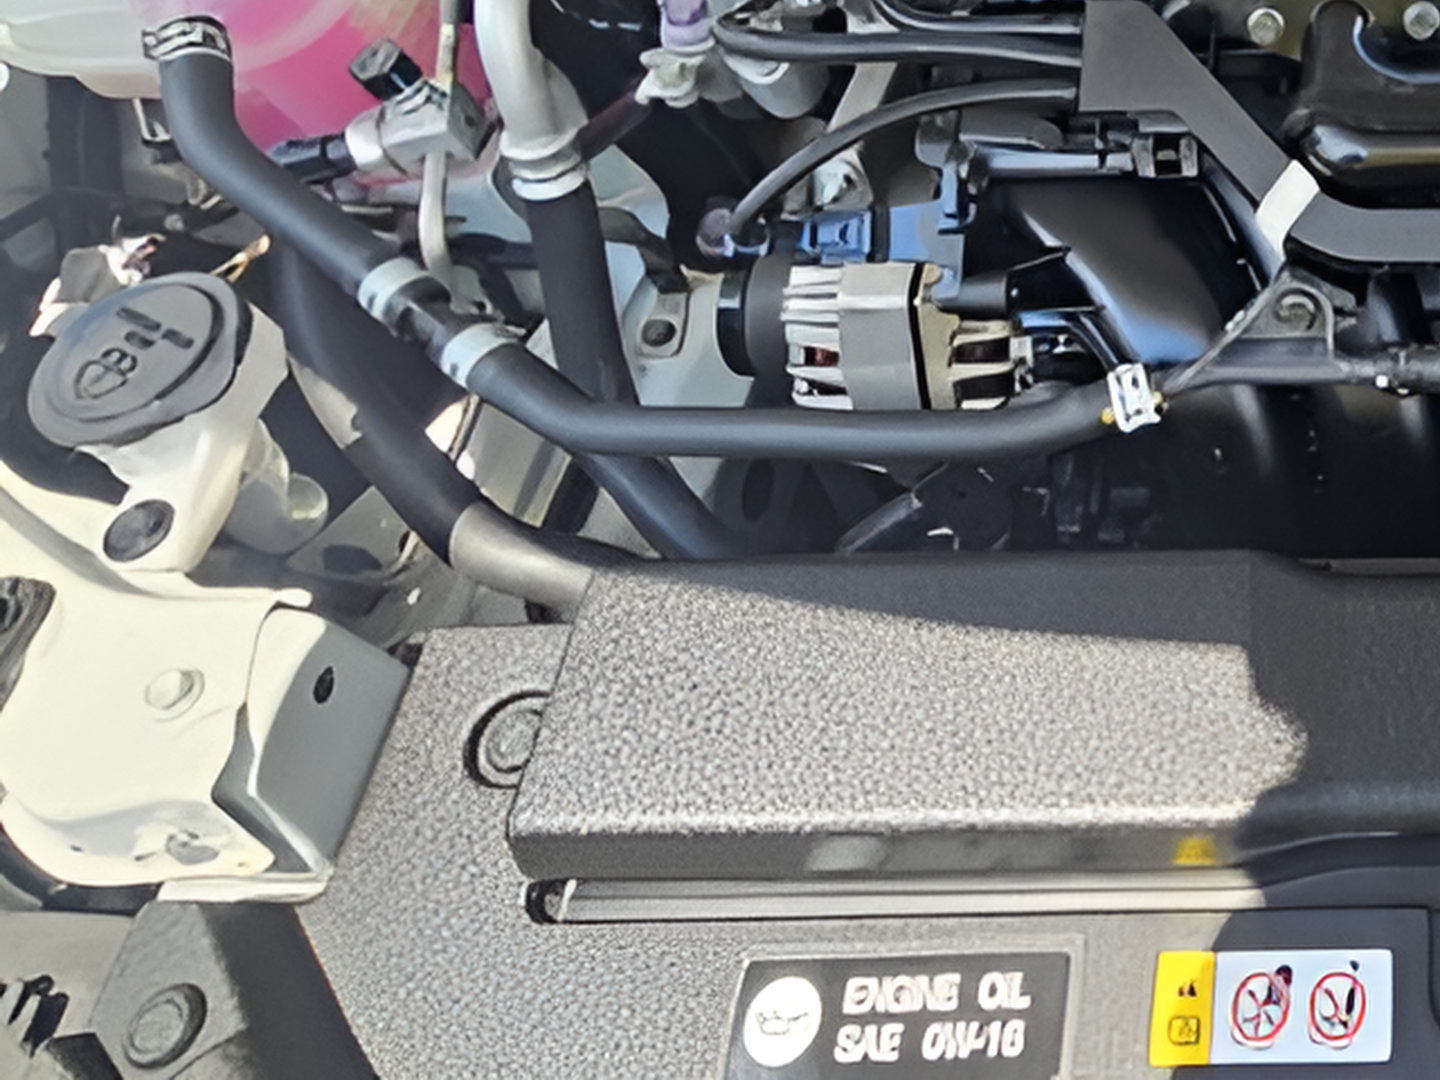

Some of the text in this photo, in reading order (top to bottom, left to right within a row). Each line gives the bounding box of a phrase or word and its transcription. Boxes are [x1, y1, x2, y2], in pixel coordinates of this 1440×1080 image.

[842, 971, 1031, 1014] ENGINE OIL
[834, 1022, 905, 1063] SAE
